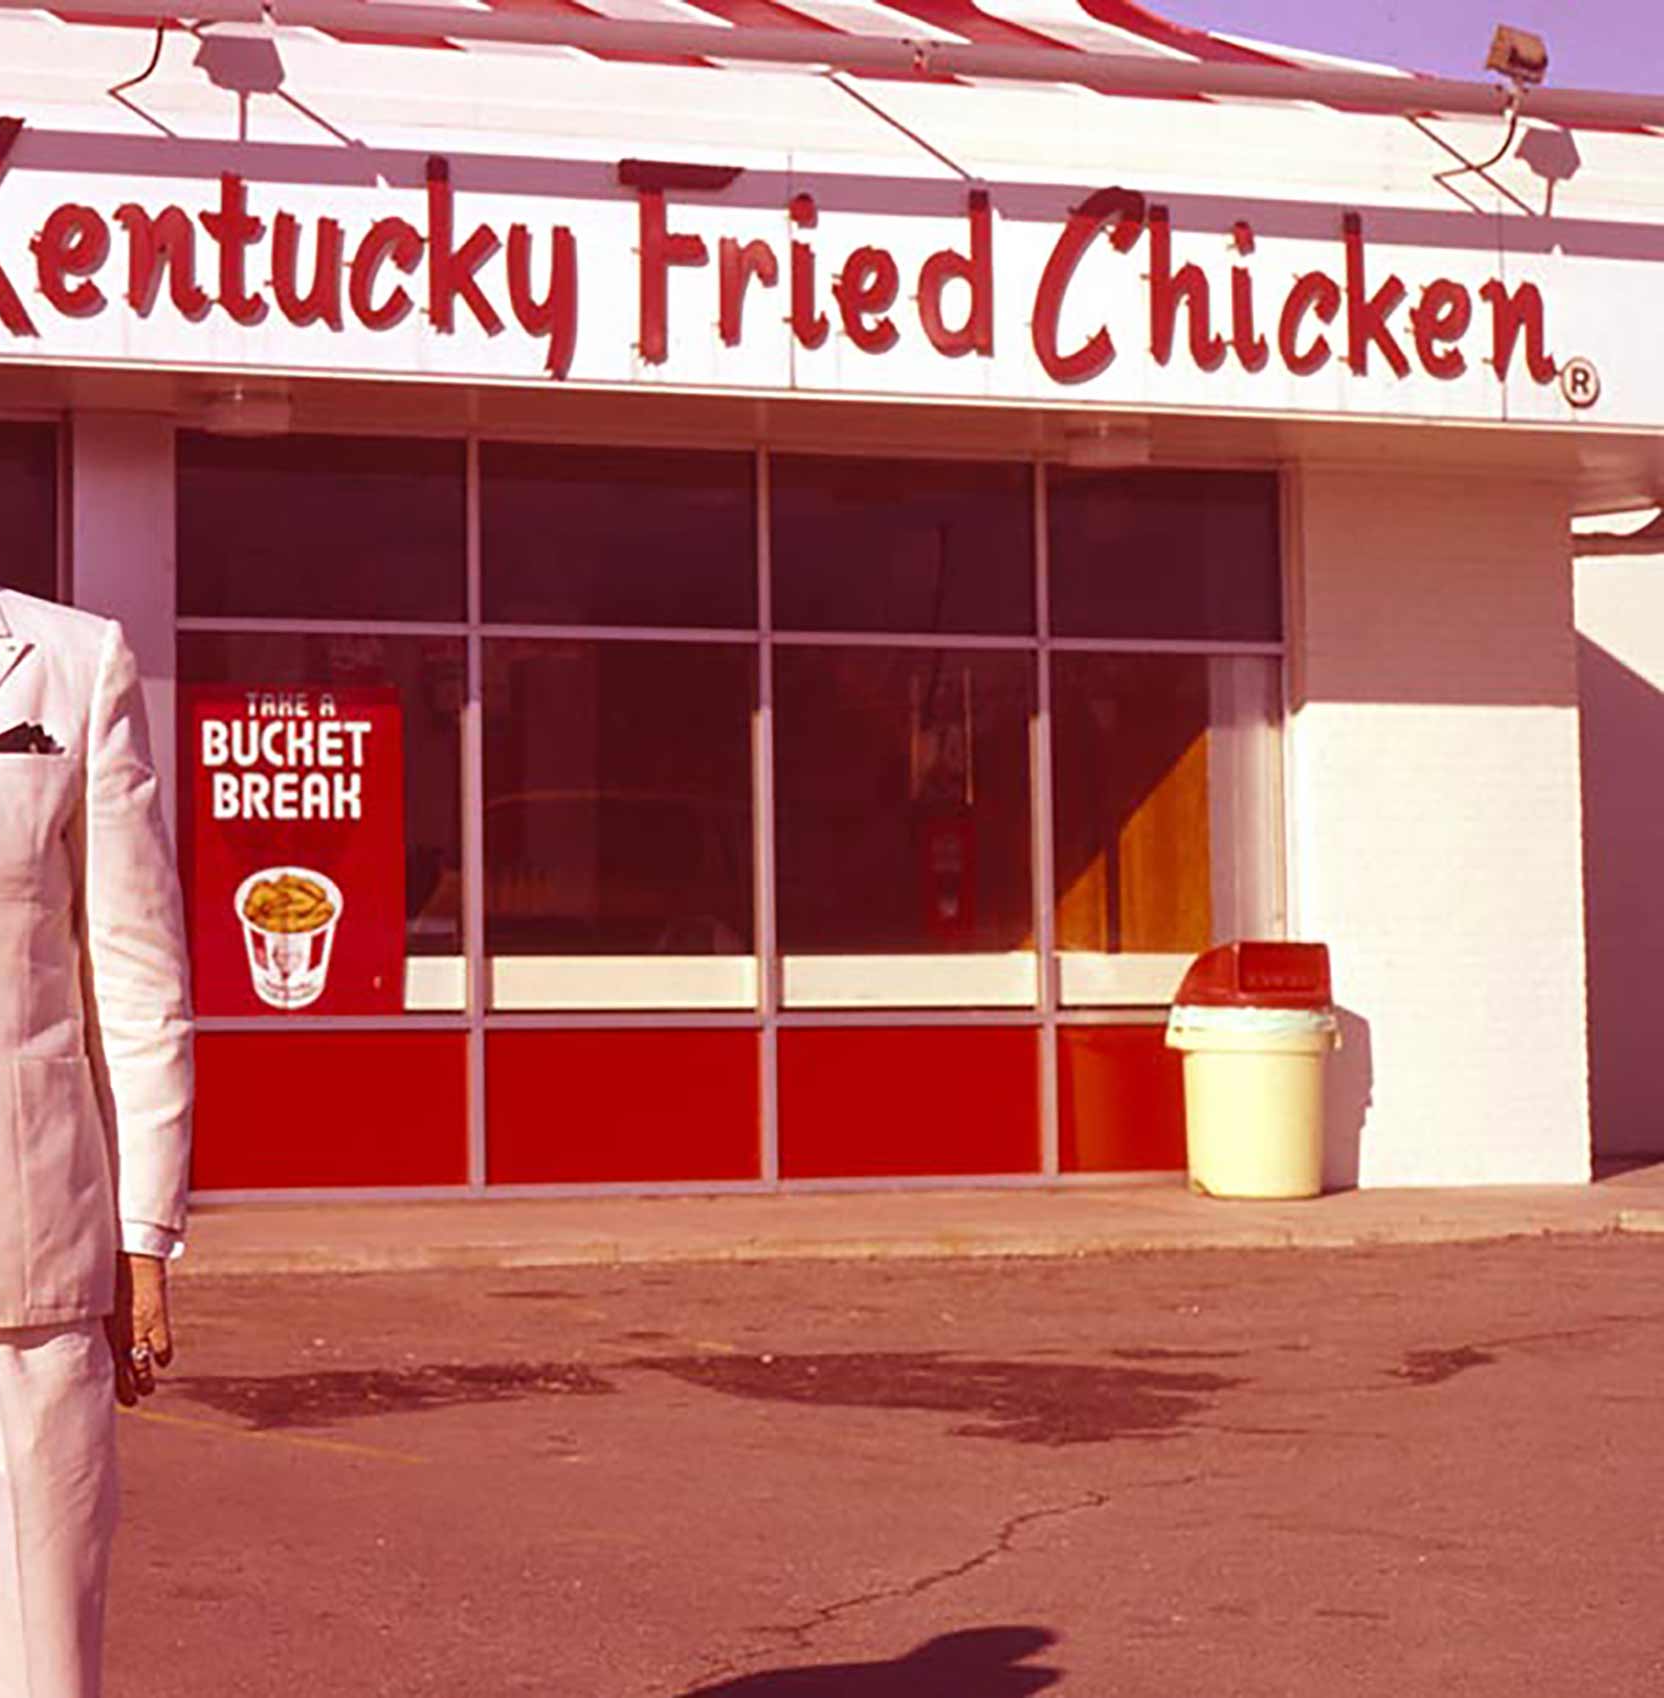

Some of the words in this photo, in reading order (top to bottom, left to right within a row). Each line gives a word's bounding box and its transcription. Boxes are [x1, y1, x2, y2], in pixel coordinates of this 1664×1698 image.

[618, 158, 995, 365] Fried
[1030, 186, 1554, 386] Chicken
[245, 692, 310, 717] TAKE
[319, 692, 336, 717] A
[200, 719, 372, 767] BUCKET
[212, 772, 362, 821] BREAK
